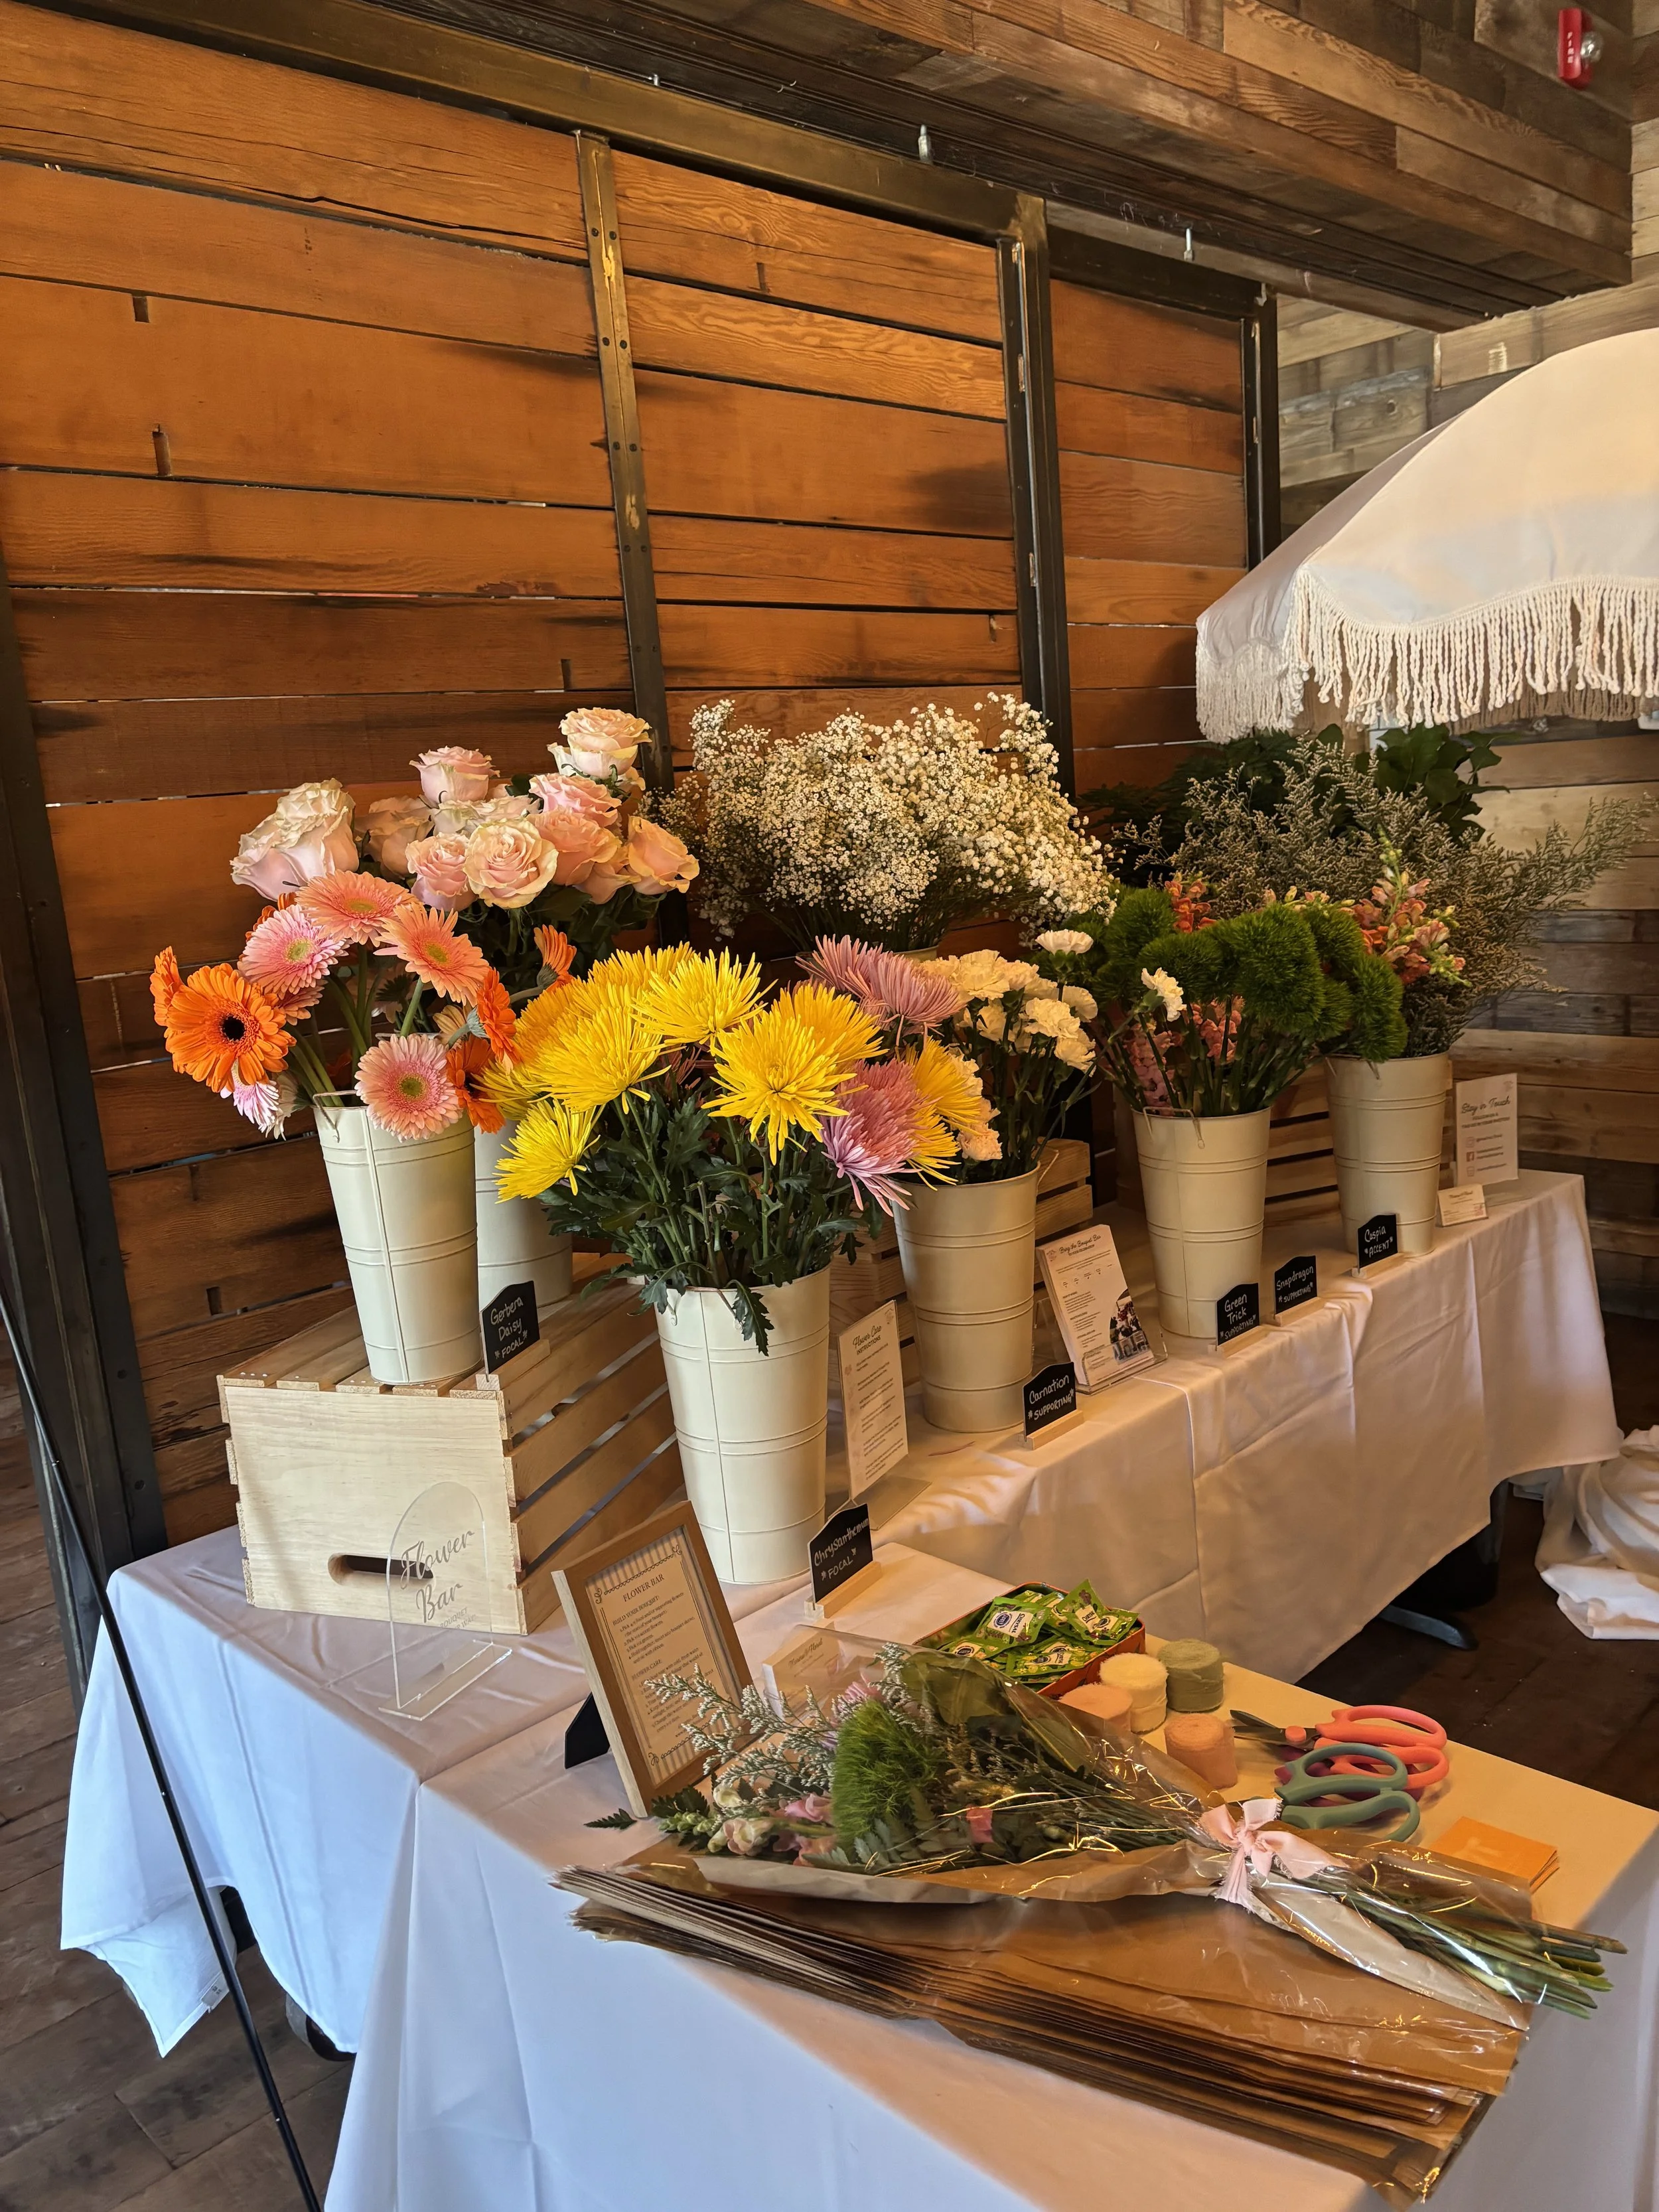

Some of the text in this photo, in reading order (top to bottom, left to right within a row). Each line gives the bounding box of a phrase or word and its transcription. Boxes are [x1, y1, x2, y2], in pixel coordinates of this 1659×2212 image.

[1489, 1096, 1510, 1106] Touch
[1364, 1226, 1386, 1242] Caspia
[1276, 1265, 1315, 1291] Snapdragon
[490, 1297, 524, 1325] Gerbera
[1224, 1293, 1248, 1313] Green
[1227, 1307, 1247, 1325] Trick
[498, 1318, 522, 1341] Daisy
[853, 1325, 882, 1349] Flower Care
[857, 1335, 881, 1355] INSTRUCTIONS
[1029, 1375, 1070, 1404] Carnation
[399, 1528, 475, 1589] Flower
[623, 1574, 664, 1601] FLOWER BAR
[415, 1582, 463, 1624] Bar
[613, 1615, 626, 1625] BUILD
[1011, 1613, 1025, 1633] CHRYSAL
